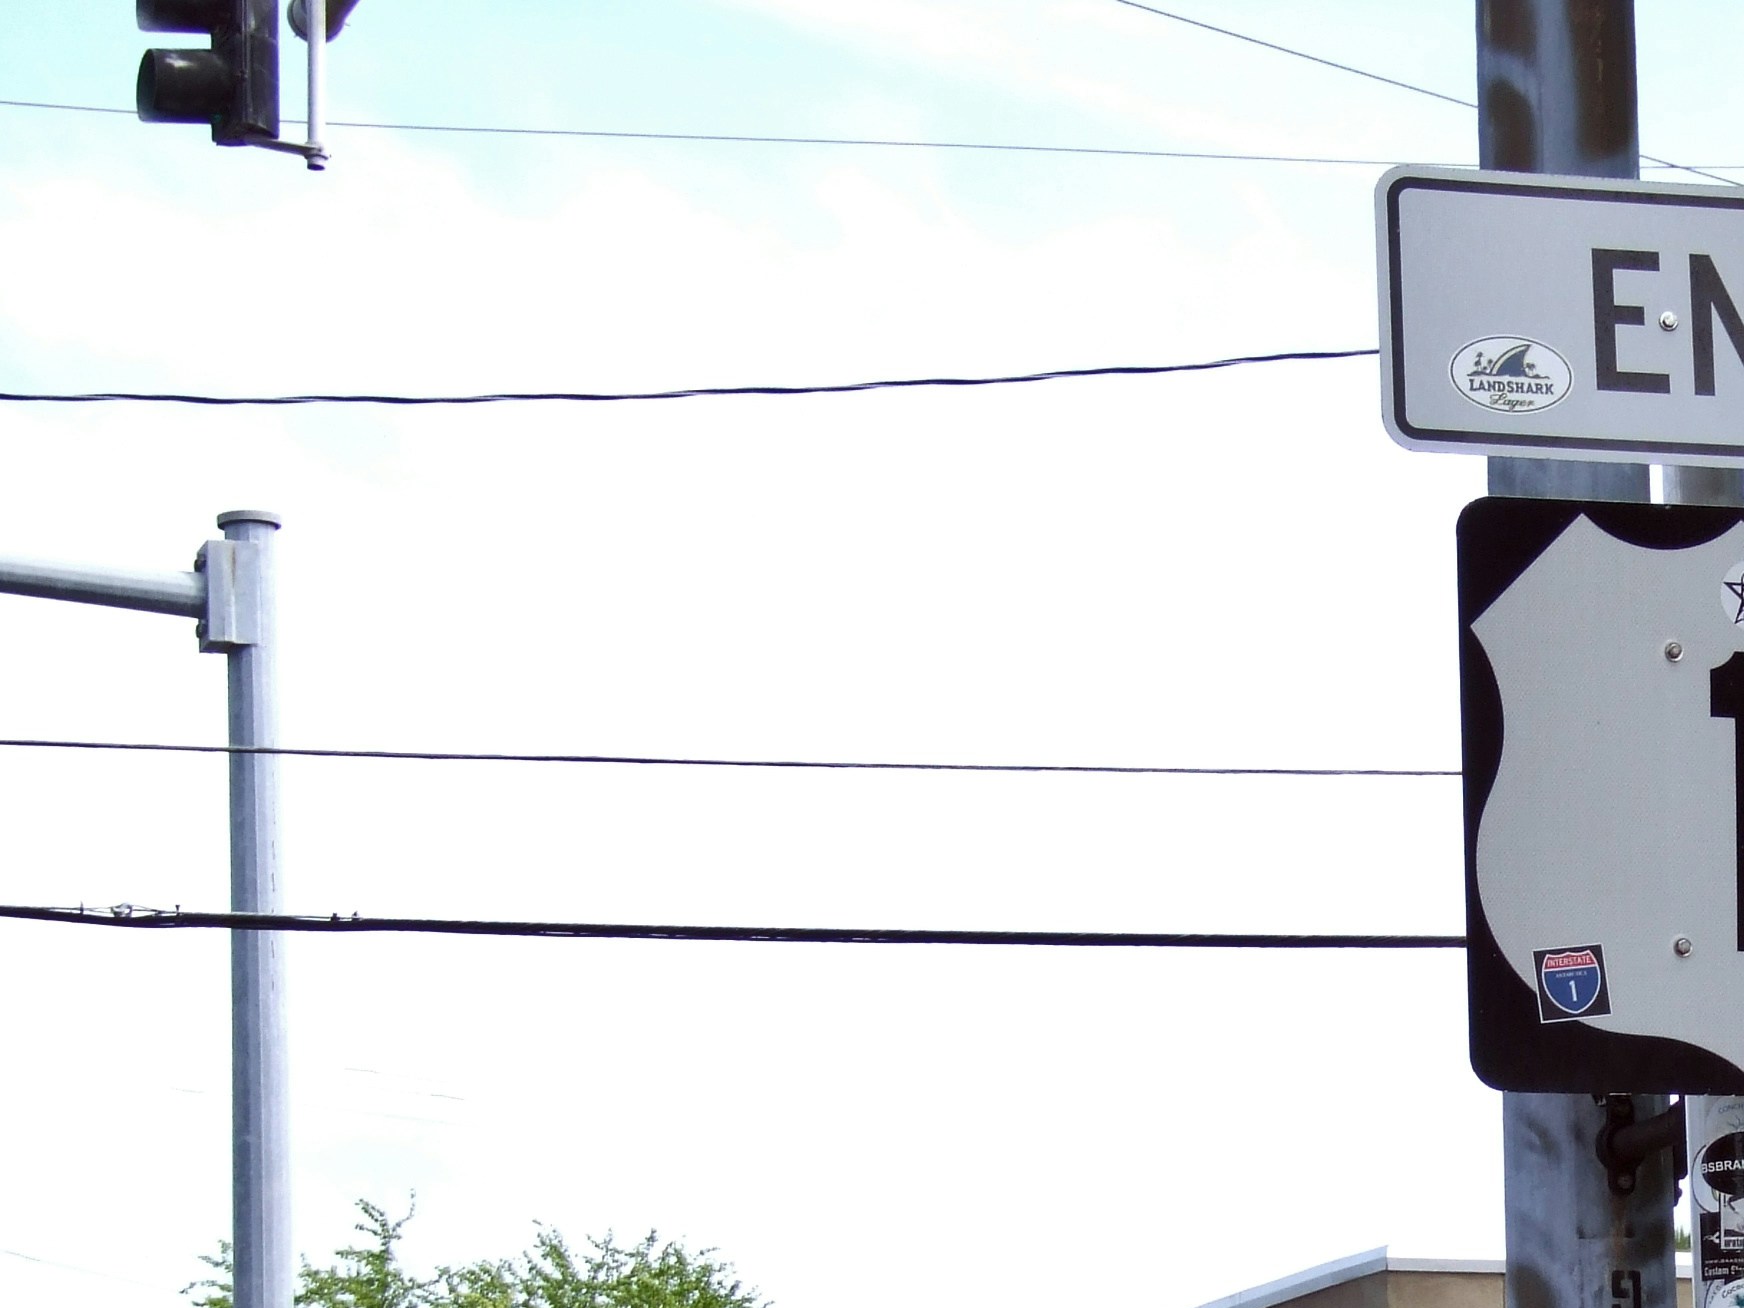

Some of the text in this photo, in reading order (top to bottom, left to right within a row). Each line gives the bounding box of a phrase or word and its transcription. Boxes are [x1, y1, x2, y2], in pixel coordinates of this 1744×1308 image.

[1468, 379, 1554, 395] LANDSHARK
[1489, 393, 1535, 412] Lager
[1547, 955, 1593, 968] INTERSTATE
[1569, 980, 1578, 1002] 1
